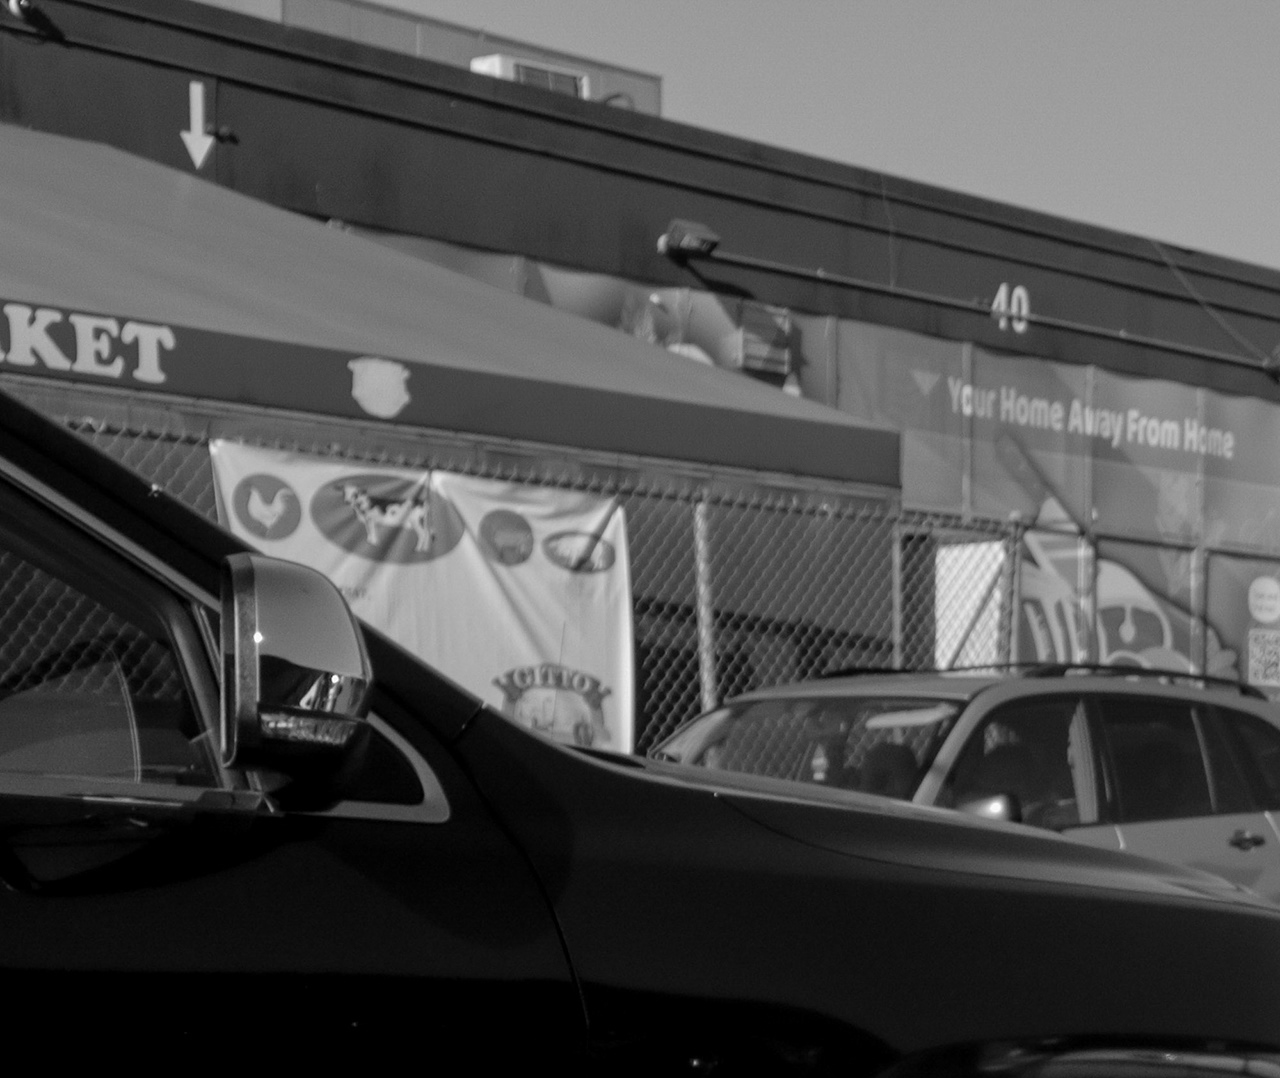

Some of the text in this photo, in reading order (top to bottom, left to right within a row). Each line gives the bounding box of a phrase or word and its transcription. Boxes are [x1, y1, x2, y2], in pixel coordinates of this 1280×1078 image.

[991, 281, 1029, 334] 40
[0, 303, 175, 384] KET
[948, 376, 1235, 460] Your Home Away From Home
[512, 664, 590, 693] GITTO
